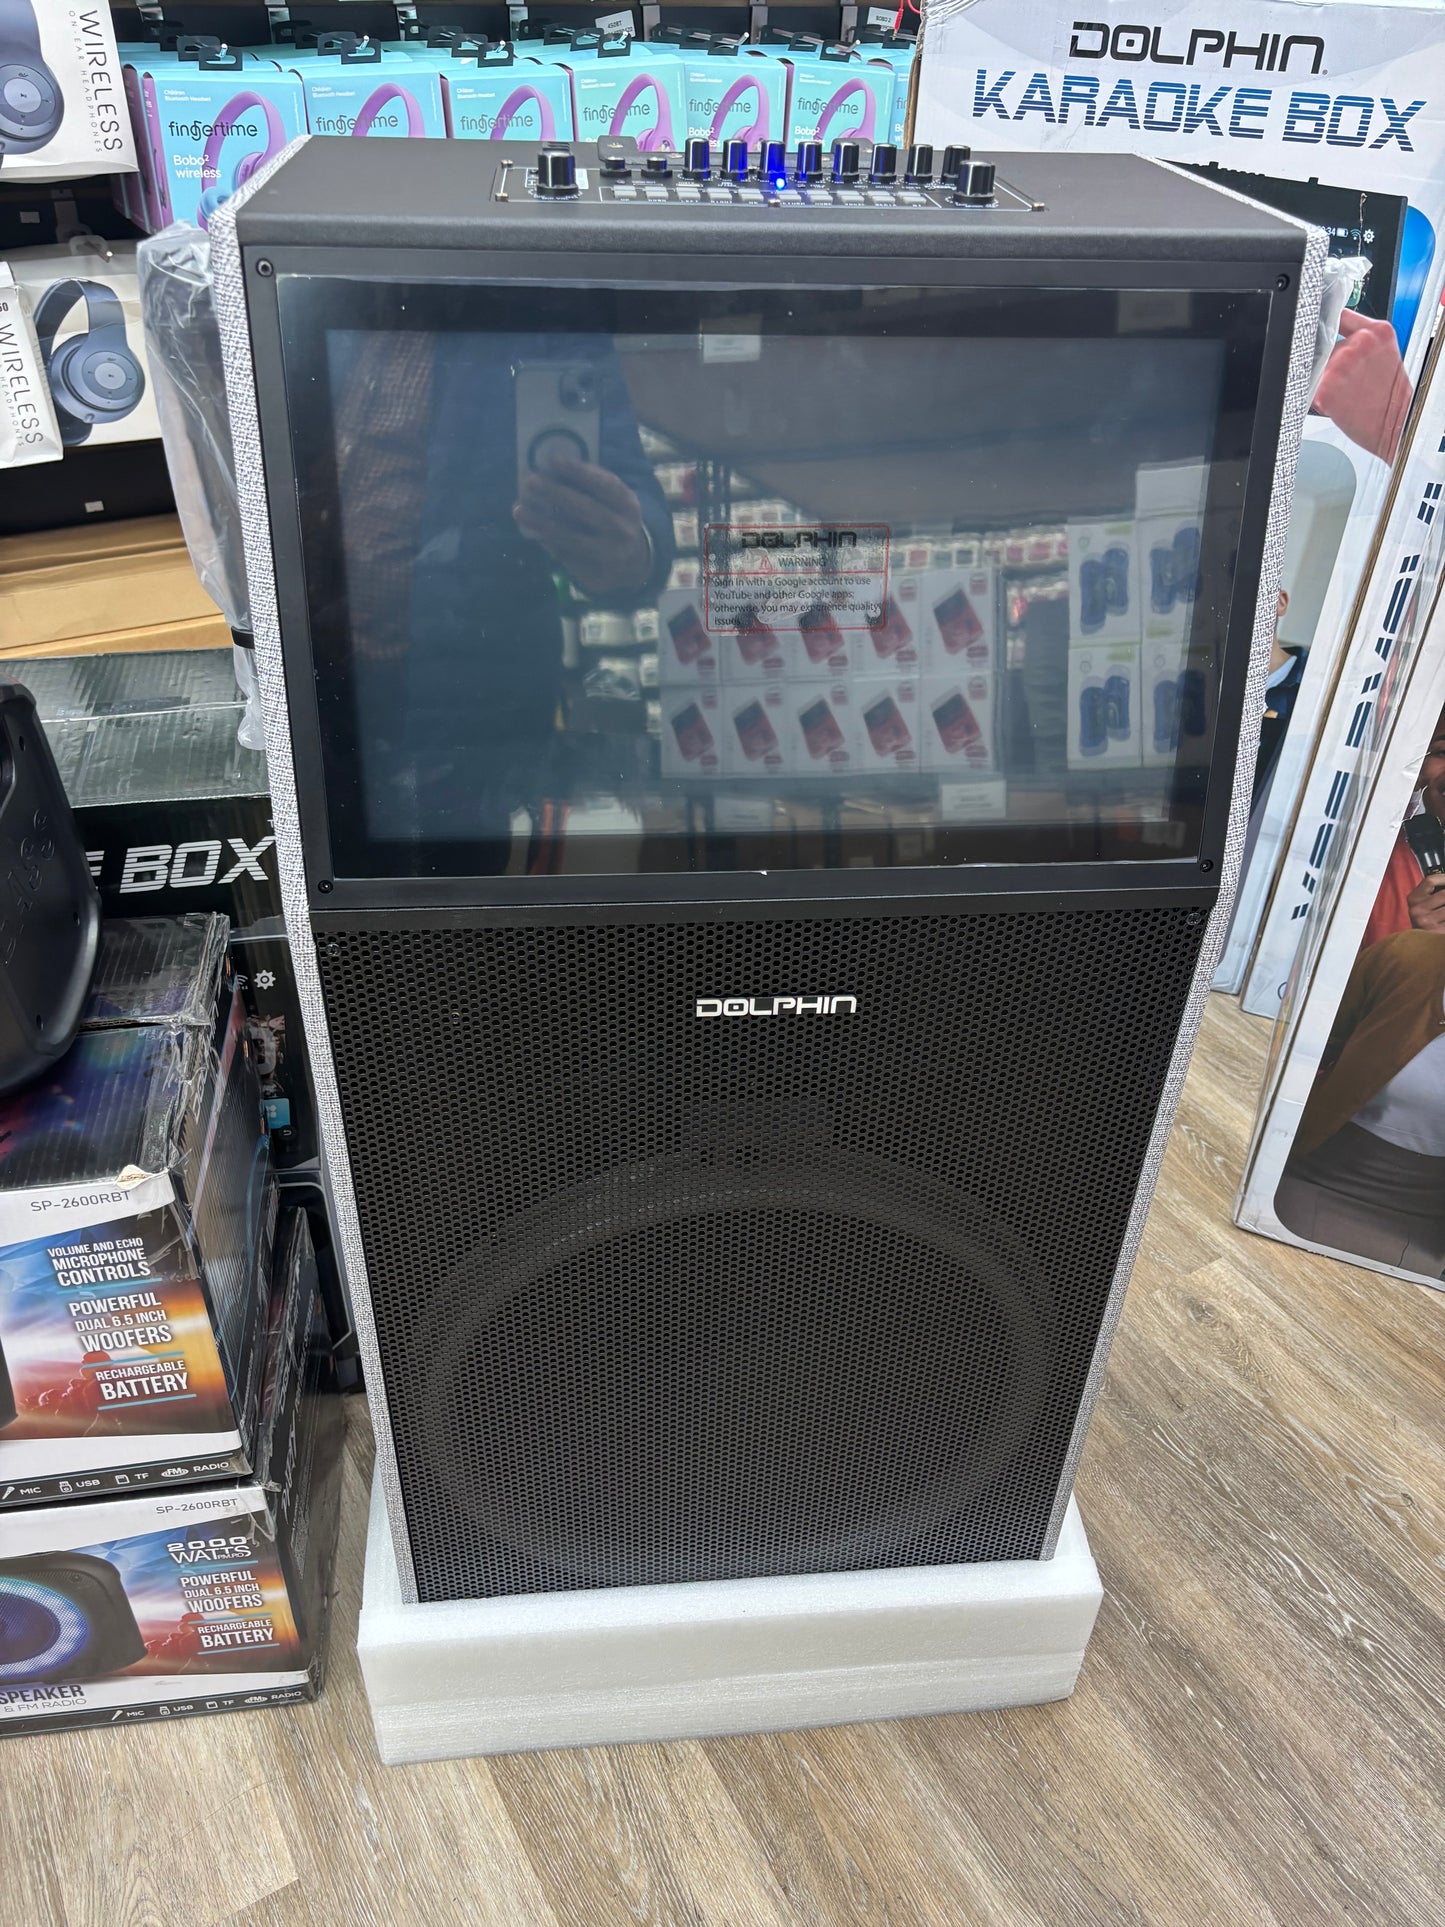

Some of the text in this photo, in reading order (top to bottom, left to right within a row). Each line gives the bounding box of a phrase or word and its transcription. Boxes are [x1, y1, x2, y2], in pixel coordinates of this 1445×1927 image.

[1069, 21, 1325, 74] DOLPHIN
[79, 10, 123, 151] WIRELESS
[80, 70, 103, 152] HEADPHONES
[973, 69, 1427, 152] KARAOKE BOX
[168, 120, 258, 141] fingertime
[175, 167, 222, 179] wireless
[742, 531, 857, 548] DOLPHIN
[778, 557, 826, 567] WARNING
[714, 577, 734, 588] Sign
[747, 577, 766, 586] with
[775, 577, 807, 588] Google
[808, 577, 843, 586] account
[845, 577, 854, 586] to
[856, 578, 871, 586] use
[714, 591, 753, 600] YouTube
[754, 591, 771, 600] and
[773, 591, 796, 600] other
[798, 590, 830, 601] Google
[761, 605, 778, 614] you
[780, 605, 799, 614] may
[800, 603, 847, 614] experience
[849, 602, 879, 613] quality
[119, 836, 277, 894] BOX
[696, 996, 857, 1017] DOLPHIN
[30, 1190, 131, 1212] SP-2600RBT
[48, 1237, 144, 1258] VOLUME AND ECHO
[52, 1247, 147, 1271] MICROPHONE
[57, 1261, 151, 1287] CONTROLS
[68, 1292, 162, 1317] POWERFUL
[75, 1309, 167, 1332] DUAL 6.5 INCH
[80, 1325, 172, 1353] WOOFERS
[95, 1360, 186, 1381] RECHARGEABLE
[100, 1372, 189, 1401] BATTERY
[20, 1486, 42, 1495] MIC
[76, 1479, 100, 1488] USB
[193, 1461, 229, 1473] RADIO
[156, 1498, 237, 1514] SP-2600RBT
[167, 1536, 247, 1552] 2000
[170, 1545, 252, 1564] WATTS
[180, 1570, 256, 1588] POWERFUL
[184, 1583, 260, 1599] DUAL 6.5 INCH
[188, 1594, 263, 1613] WOOFERS
[197, 1619, 273, 1634] RECHARGEABLE
[200, 1627, 274, 1648] BATTERY
[0, 1685, 84, 1705] SPEAKER
[17, 1703, 39, 1711] FM
[42, 1698, 87, 1708] RADIO
[271, 1691, 302, 1700] RADIO
